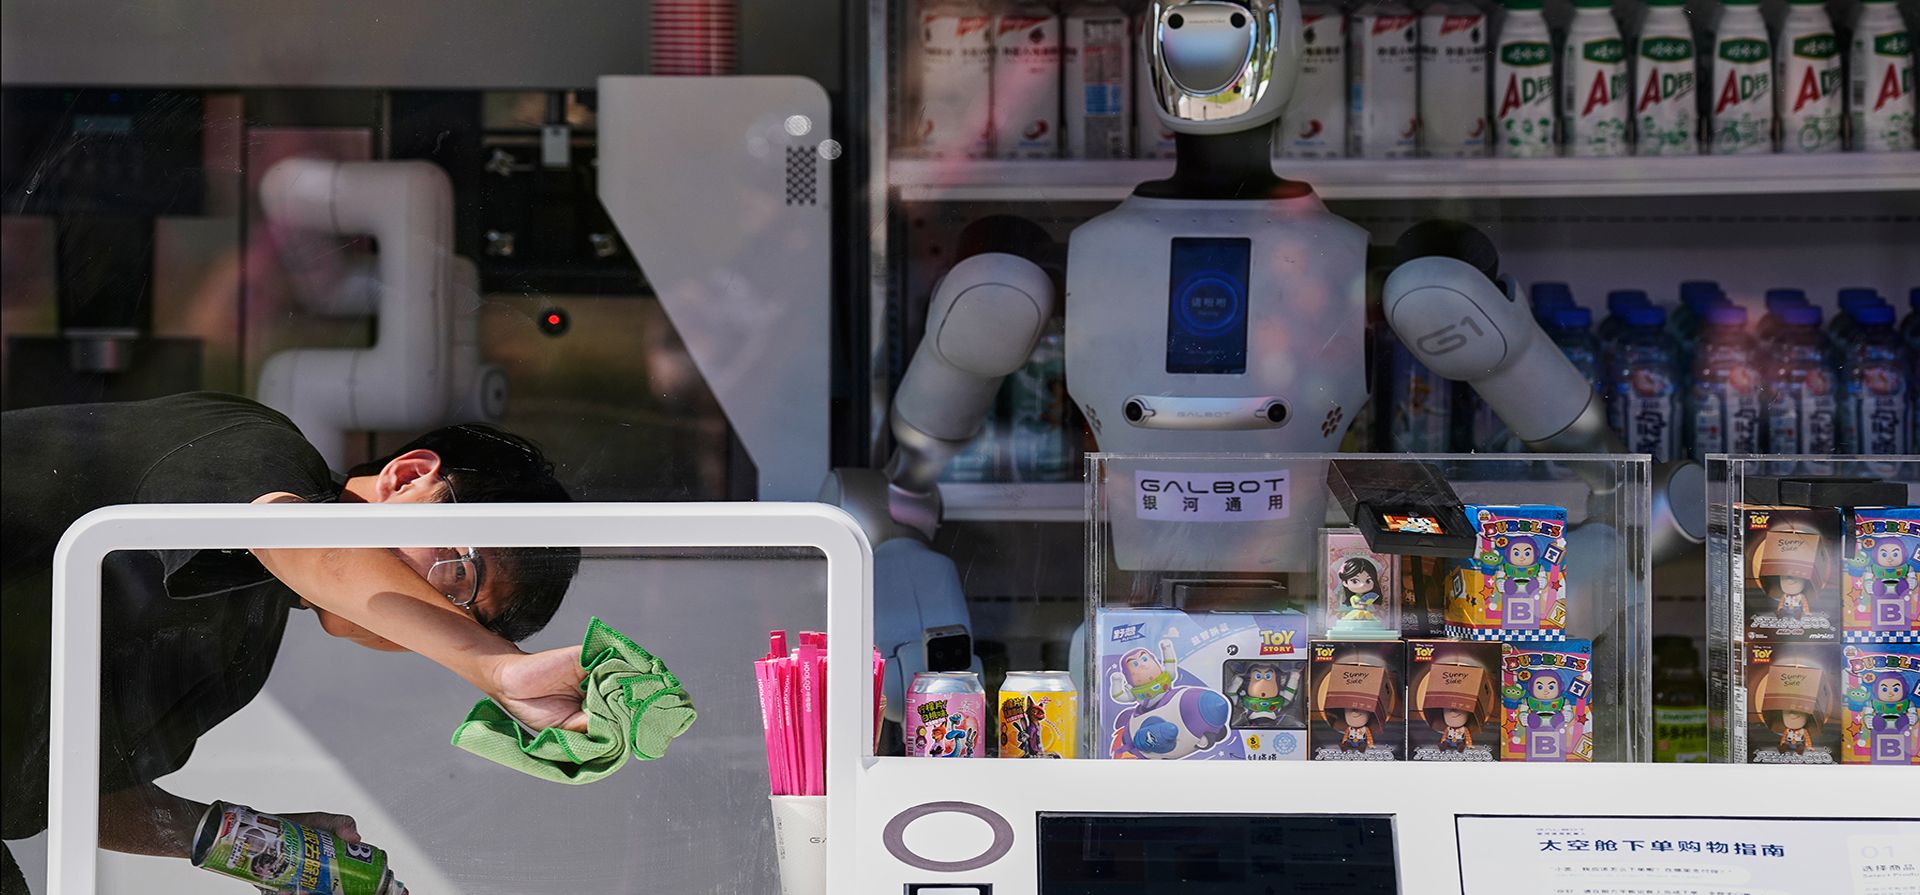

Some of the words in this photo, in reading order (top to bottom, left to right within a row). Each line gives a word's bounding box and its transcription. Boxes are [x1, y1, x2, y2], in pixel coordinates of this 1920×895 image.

[1417, 315, 1485, 356] G1
[1176, 410, 1232, 418] GALBOT
[1140, 478, 1285, 494] GALBOT
[1143, 494, 1284, 513] 银河通用
[1750, 515, 1770, 524] TOY
[1856, 520, 1920, 537] UBBLE
[1510, 602, 1531, 620] B
[1880, 604, 1902, 622] B
[1259, 629, 1296, 645] TOY
[1316, 648, 1335, 657] TOY
[1415, 648, 1435, 657] TOY
[1753, 649, 1773, 658] TOY
[1850, 655, 1920, 674] BUBBLE
[1343, 671, 1370, 681] Sunny
[1442, 671, 1469, 681] Sunny
[1780, 673, 1808, 682] Sunny
[1535, 735, 1557, 755] B
[1880, 738, 1902, 758] B
[1539, 839, 1786, 858] 太空舱下单购物指南
